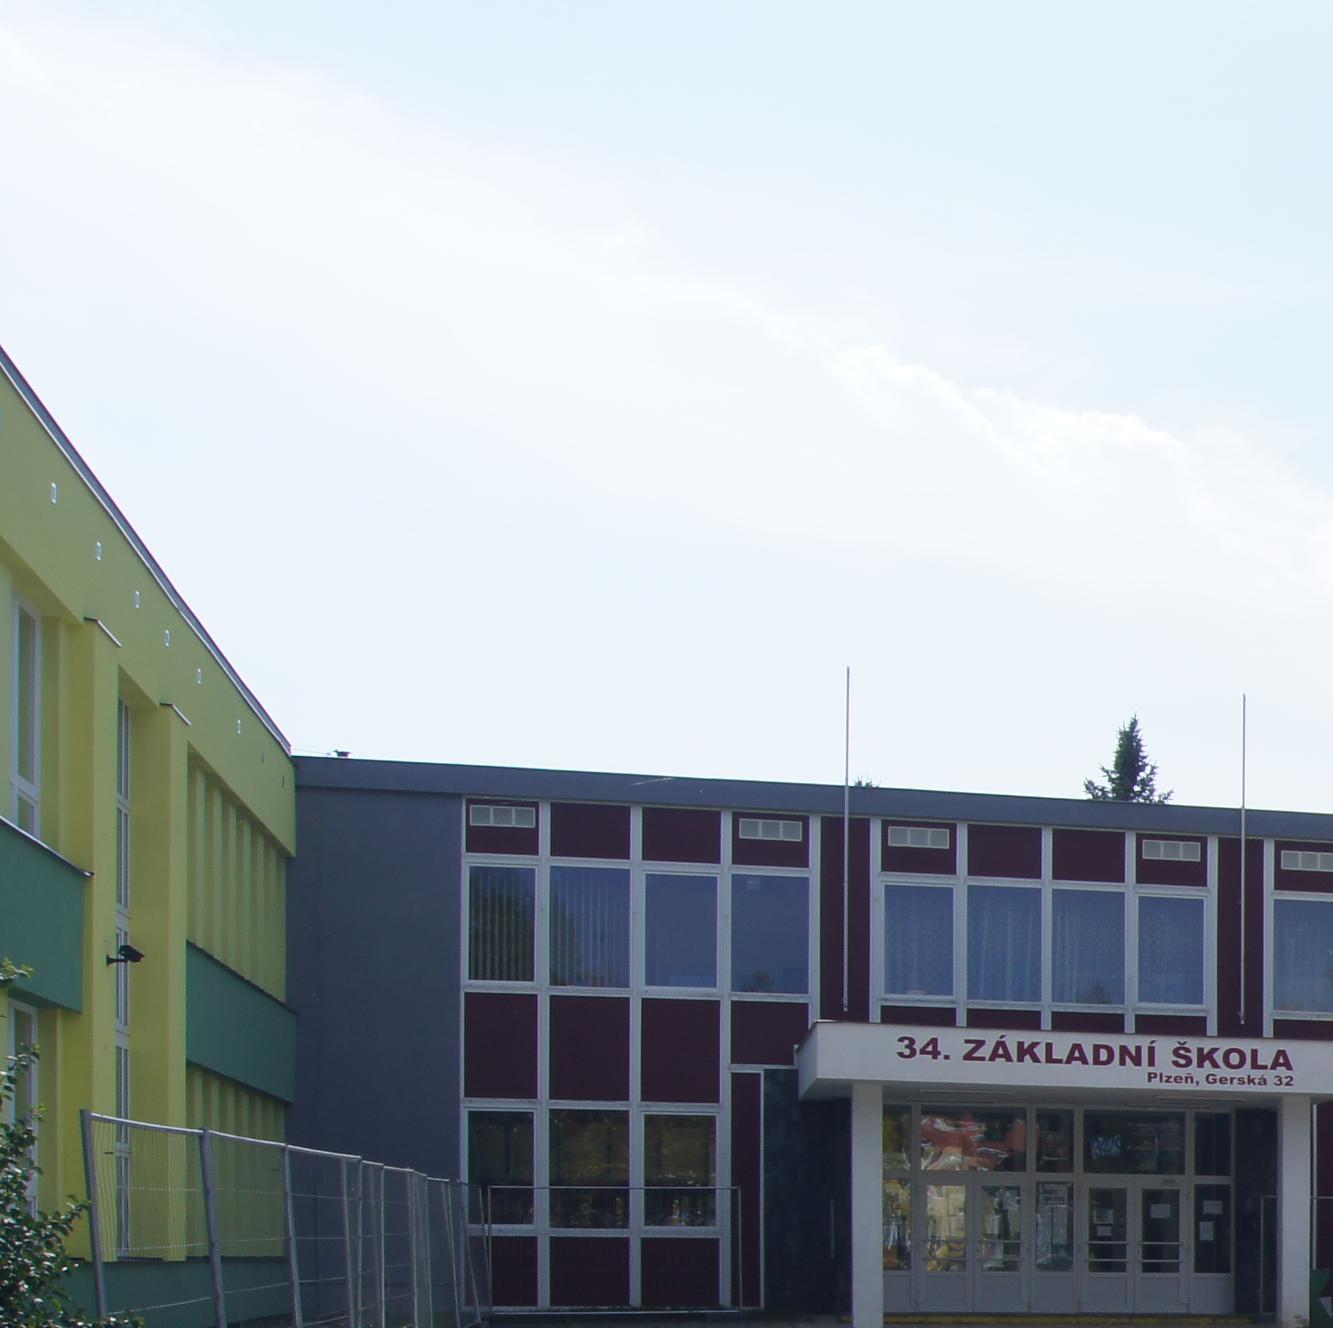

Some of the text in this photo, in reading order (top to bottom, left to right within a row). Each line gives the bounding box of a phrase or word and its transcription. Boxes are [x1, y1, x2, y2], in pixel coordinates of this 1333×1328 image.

[896, 1033, 1294, 1071] 34. ZÁKLADNÍ ŠKOLA
[1147, 1071, 1295, 1087] Plzeň, Gerská 32
